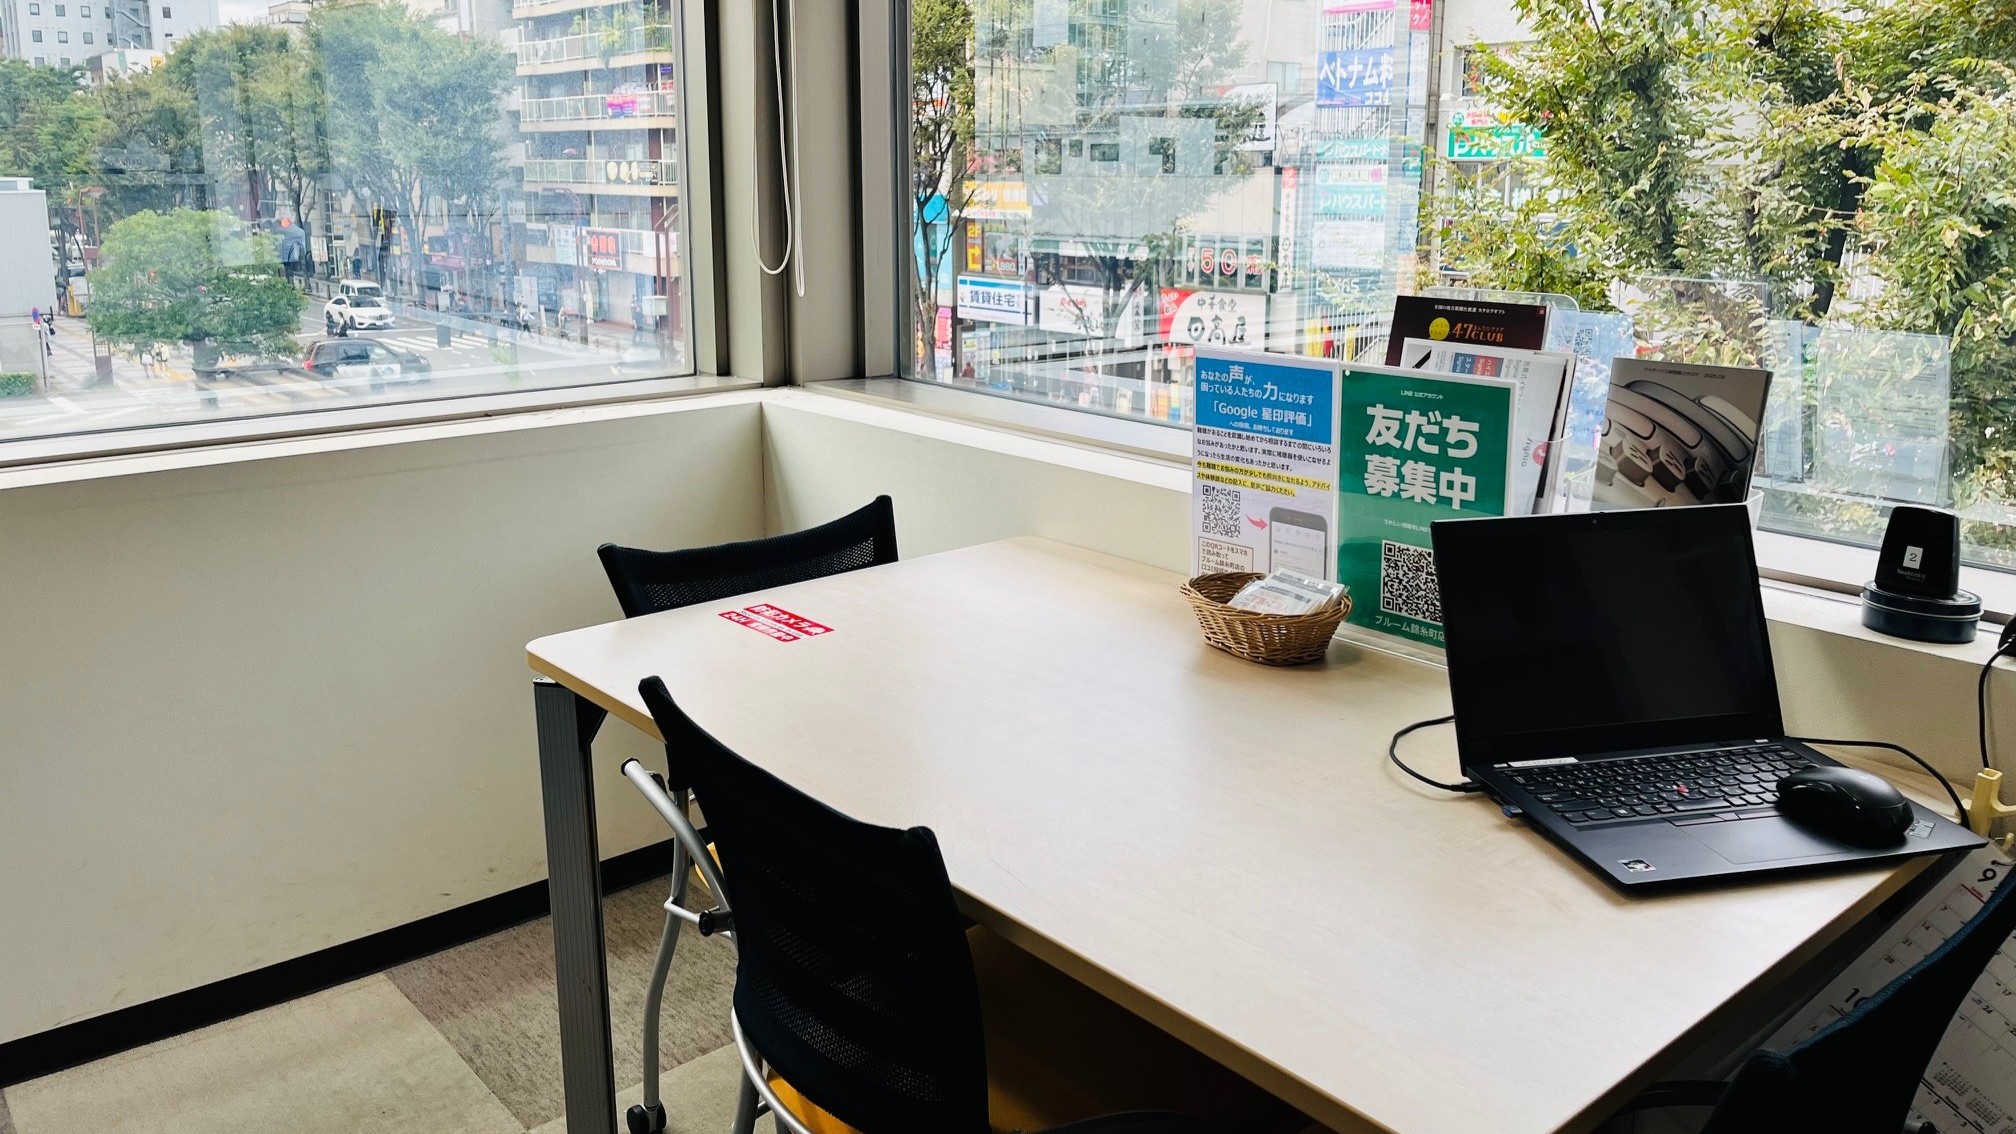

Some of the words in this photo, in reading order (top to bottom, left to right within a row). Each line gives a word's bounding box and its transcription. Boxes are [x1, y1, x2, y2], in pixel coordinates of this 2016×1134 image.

[969, 289, 1016, 308] 賃貸住宅
[1197, 295, 1238, 313] 中華食堂
[1187, 314, 1248, 346] 日高屋
[1200, 364, 1256, 386] あなたの声が、
[1200, 381, 1314, 406] 困っている人たちの力になります
[1400, 389, 1413, 397] LINE
[1213, 401, 1258, 419] 「Google
[1364, 404, 1480, 459] 友だち
[1363, 454, 1477, 511] 募集中
[1909, 552, 1918, 562] 2
[1977, 868, 1997, 882] 9
[1921, 921, 1931, 930] 14
[1902, 938, 1912, 947] 21
[1884, 954, 1895, 964] 28
[2002, 988, 2012, 997] 17
[1983, 1005, 1993, 1014] 24
